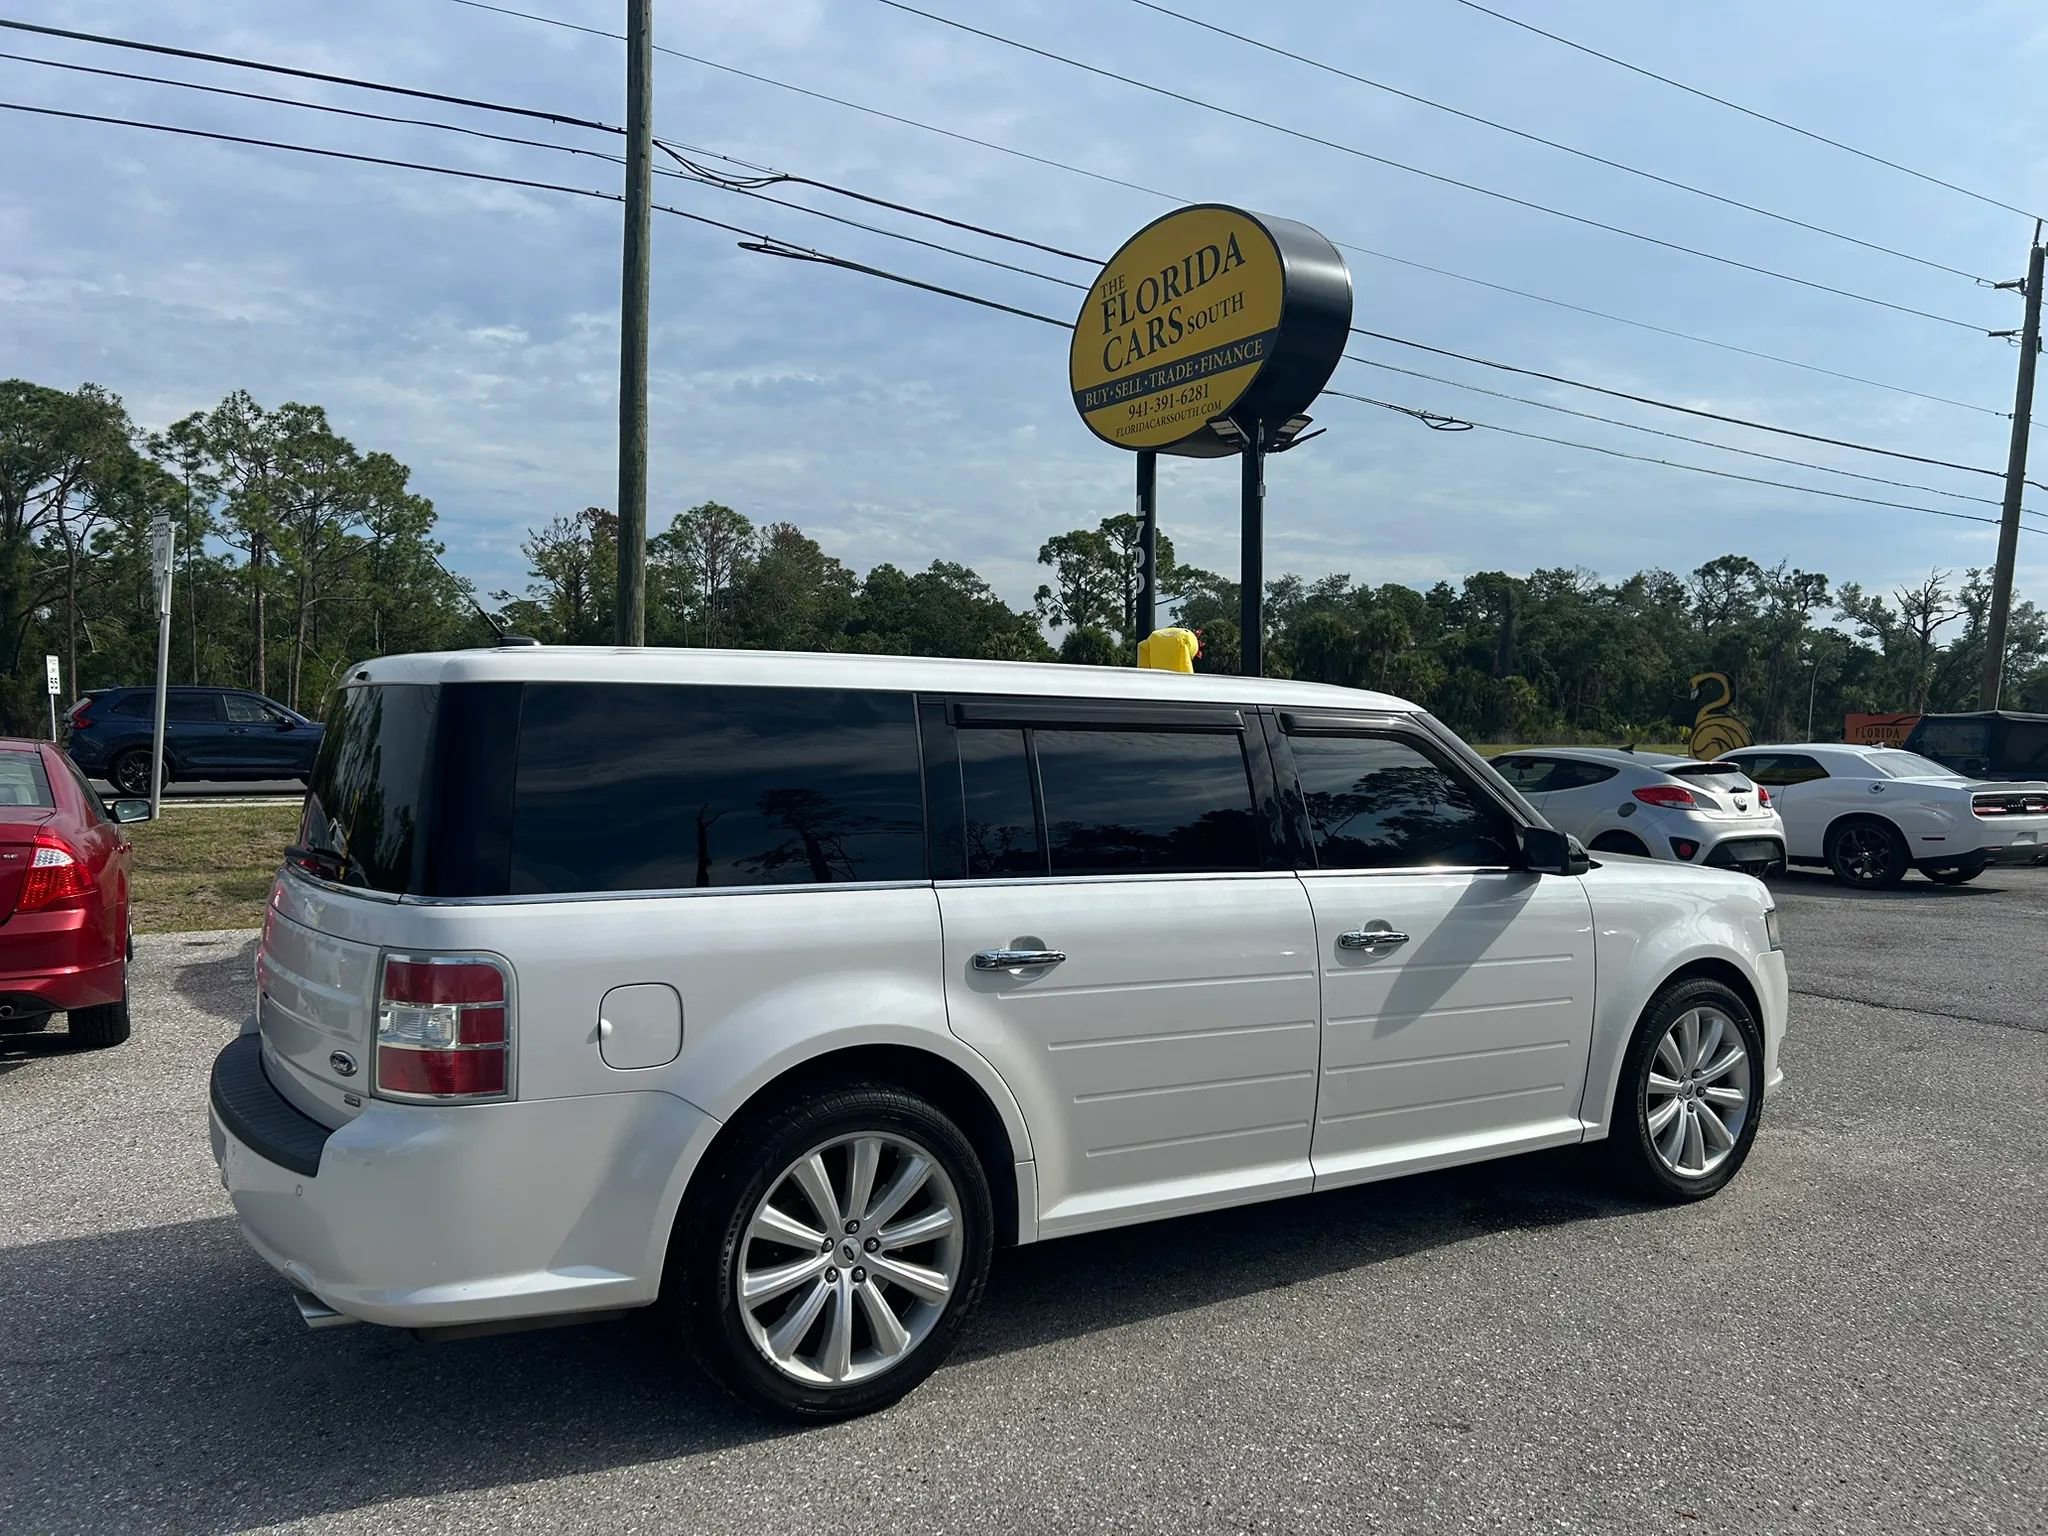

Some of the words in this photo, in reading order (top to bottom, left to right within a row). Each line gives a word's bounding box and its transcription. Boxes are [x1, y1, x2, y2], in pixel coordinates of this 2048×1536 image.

[1100, 274, 1125, 298] THE
[1101, 231, 1246, 335] FLORIDA
[1103, 305, 1184, 373] CARS
[1187, 291, 1244, 334] SOUTH
[1085, 387, 1110, 408] BUY
[1115, 377, 1143, 399] SELL
[1149, 361, 1194, 388] TRADE
[1200, 339, 1263, 373] FINANCE
[1116, 400, 1221, 438] FLORIDACARSSOUTH.COM
[1128, 382, 1209, 420] 941-391-6281
[1855, 727, 1900, 738] FLORIDA
